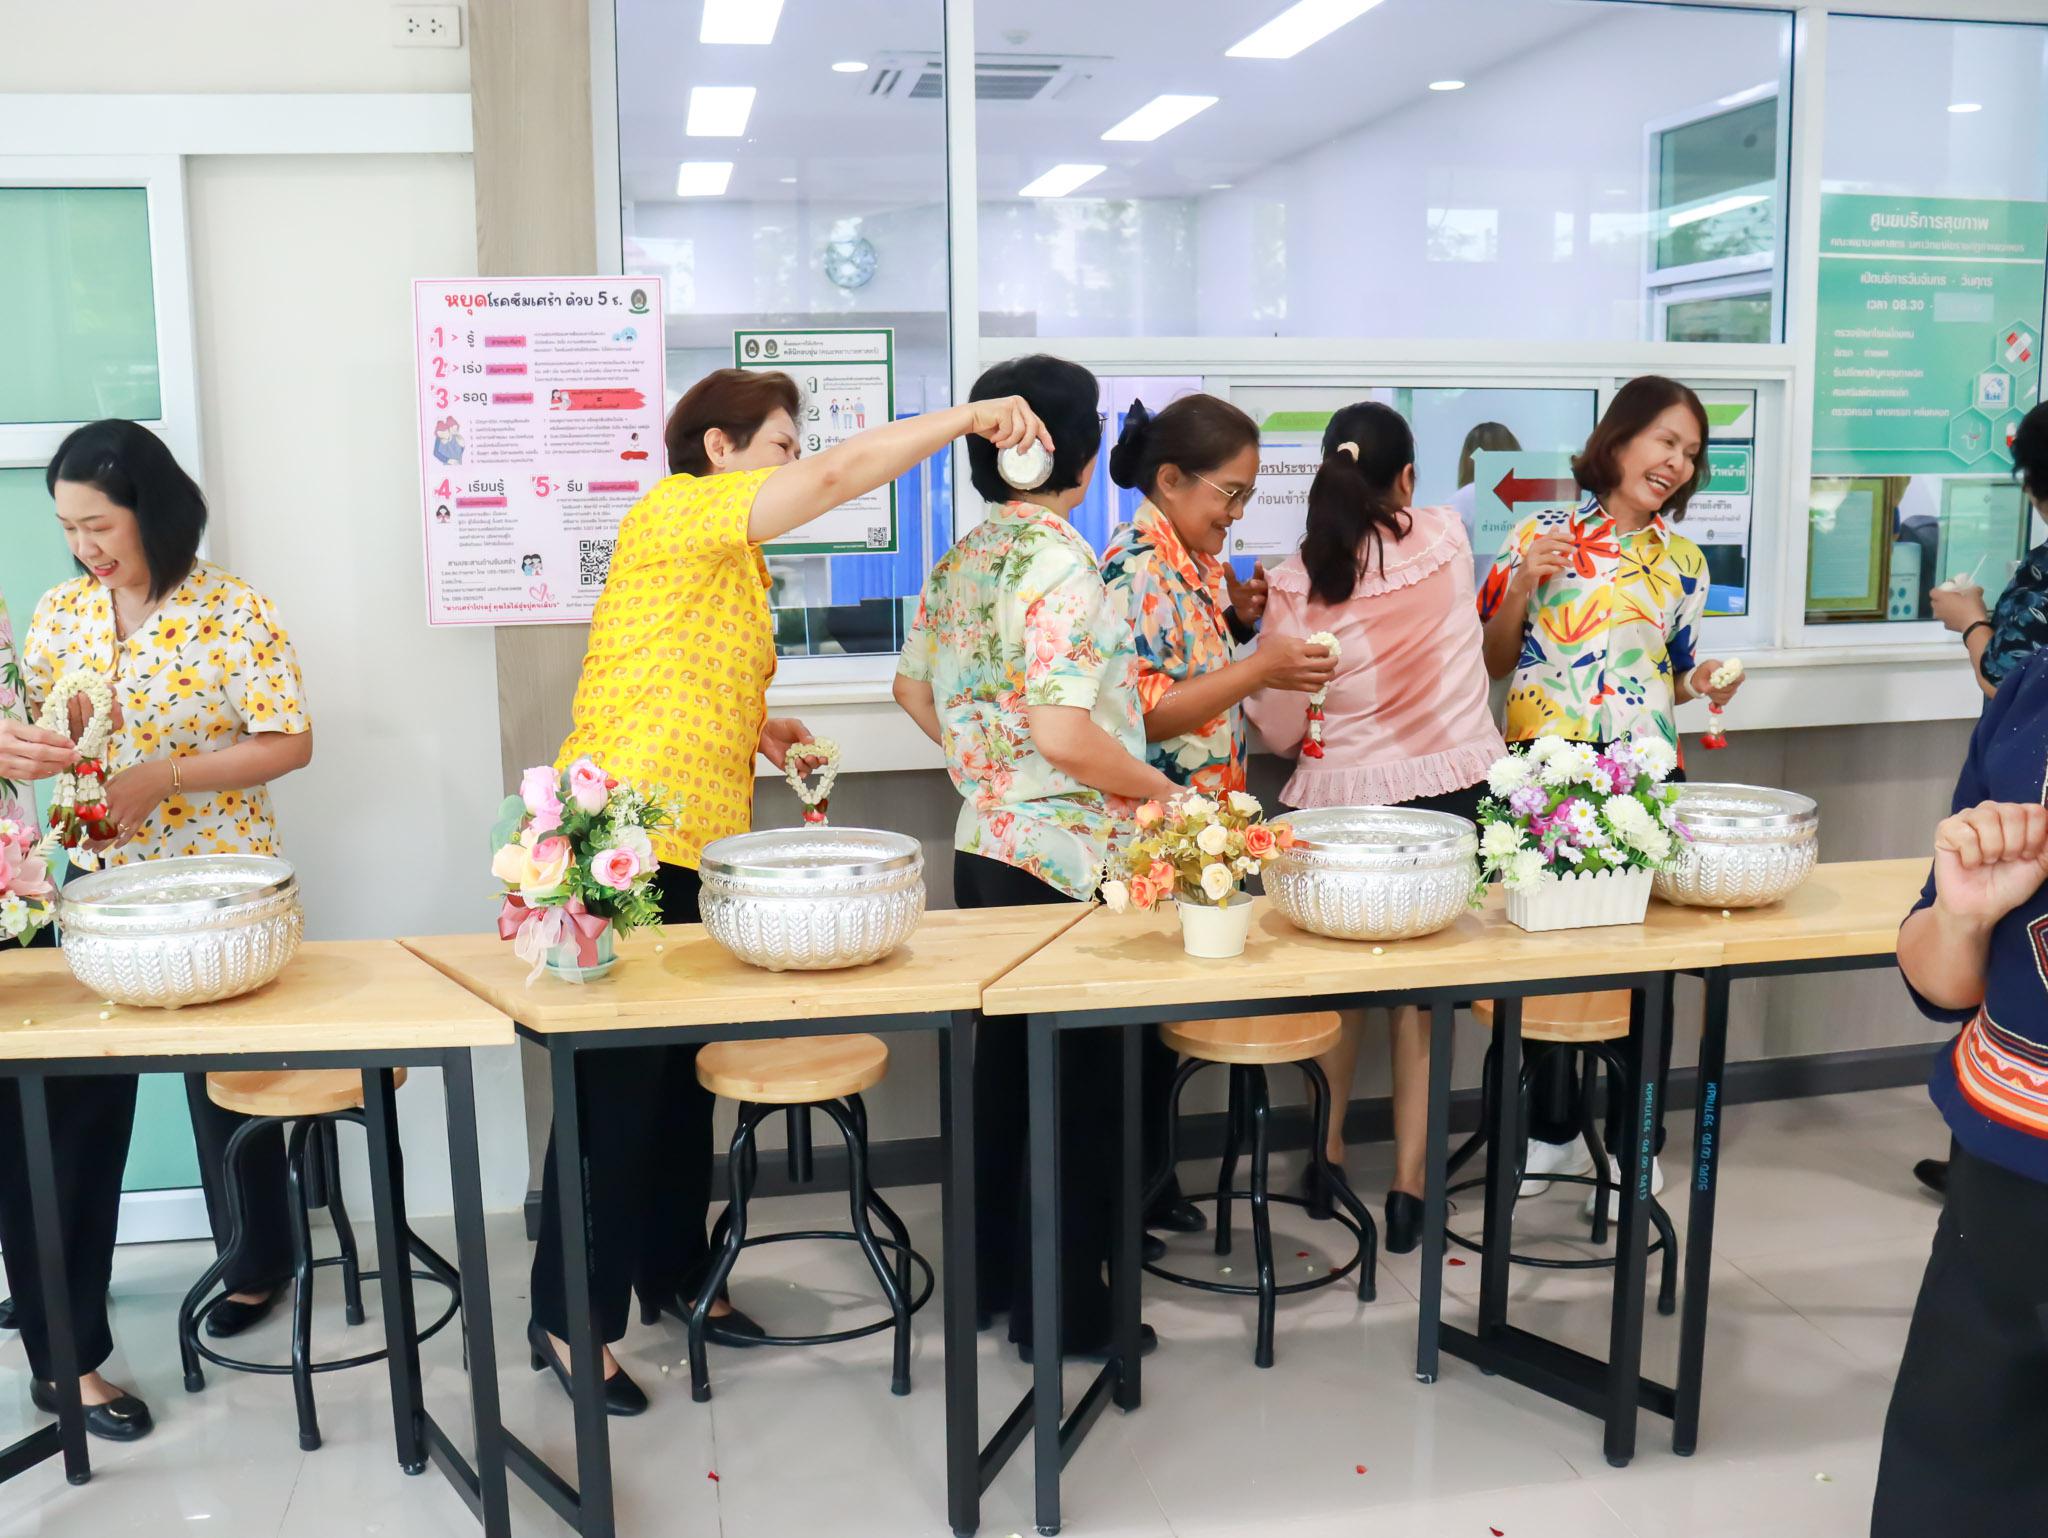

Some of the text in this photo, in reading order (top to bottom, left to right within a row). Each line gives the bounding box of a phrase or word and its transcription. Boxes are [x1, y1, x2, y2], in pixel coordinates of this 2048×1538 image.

[1870, 207, 1990, 234] ศูนย์บริการสุขภาพ
[444, 291, 623, 316] หยุดโรคซึมเศร้า ด้วย 5 ร.
[1866, 299, 1888, 310] เวลา
[1892, 299, 1924, 311] 08.30
[434, 326, 444, 348] 1
[467, 330, 475, 348] รู้
[432, 356, 446, 378] 2
[462, 360, 483, 374] เร่ง
[806, 376, 818, 394] 1
[436, 387, 449, 409] 3
[463, 392, 488, 406] รอดู
[807, 405, 820, 422] 2
[806, 433, 821, 452] 3
[436, 478, 451, 500] 4
[468, 478, 505, 496] เรียนรู้
[535, 476, 550, 498] 5
[567, 479, 583, 492] รีบ
